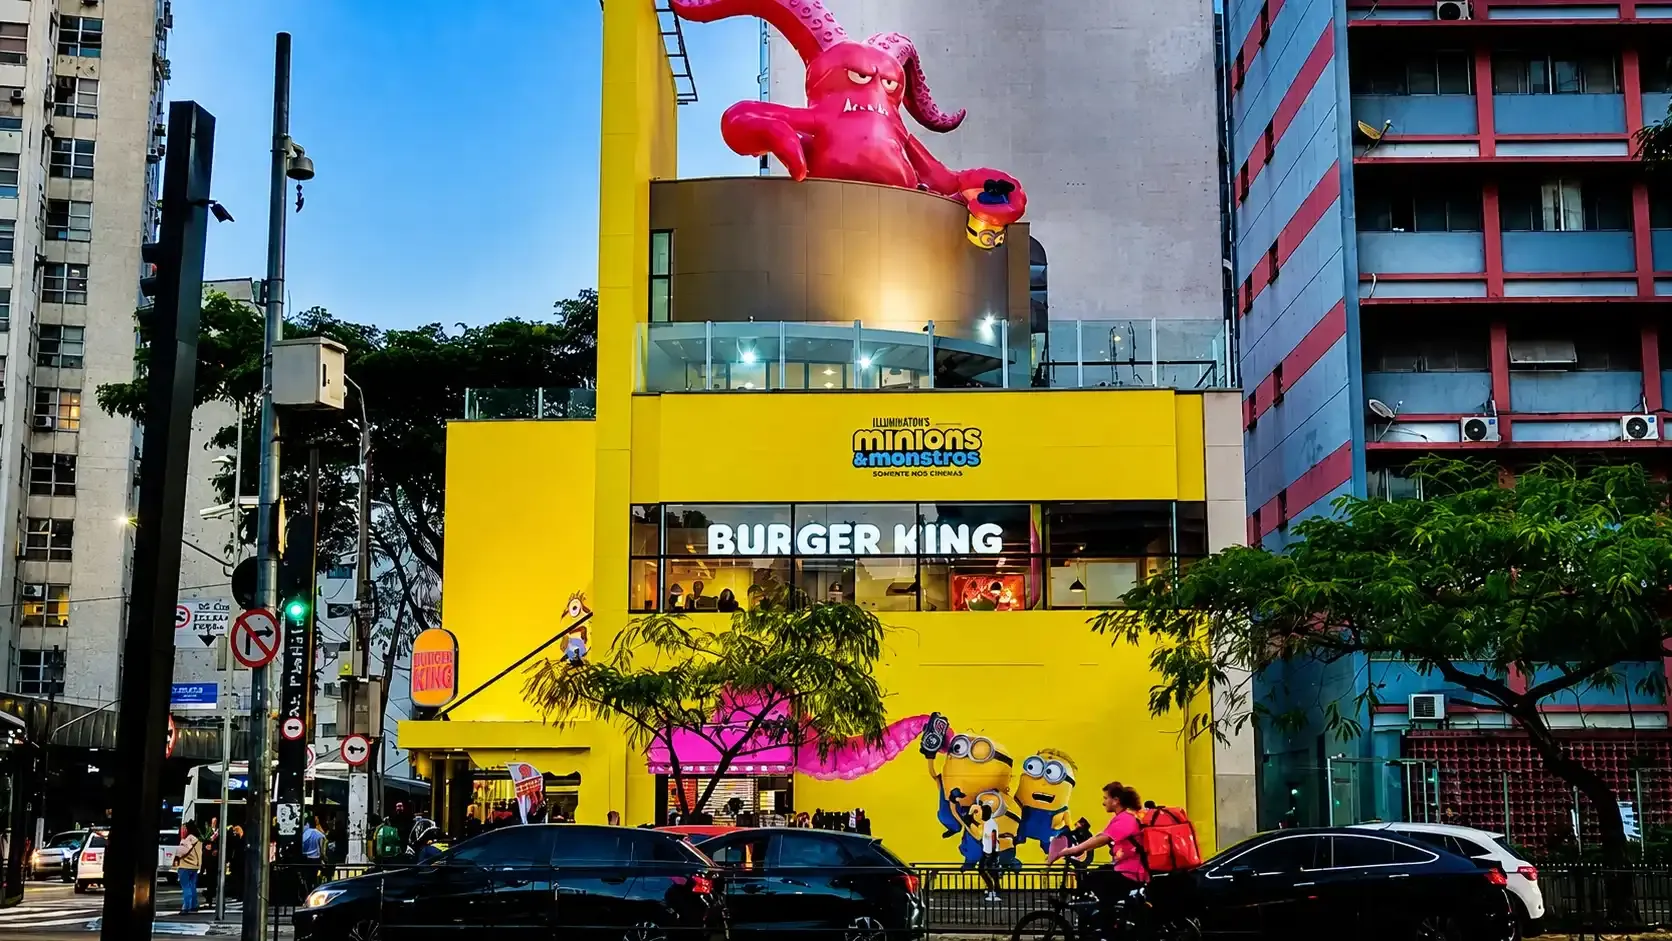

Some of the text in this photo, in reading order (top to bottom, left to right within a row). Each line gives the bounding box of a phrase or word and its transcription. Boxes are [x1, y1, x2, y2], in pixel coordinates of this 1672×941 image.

[872, 470, 910, 478] SOMENTE
[707, 523, 1004, 556] BURGER KING
[413, 664, 453, 693] KING
